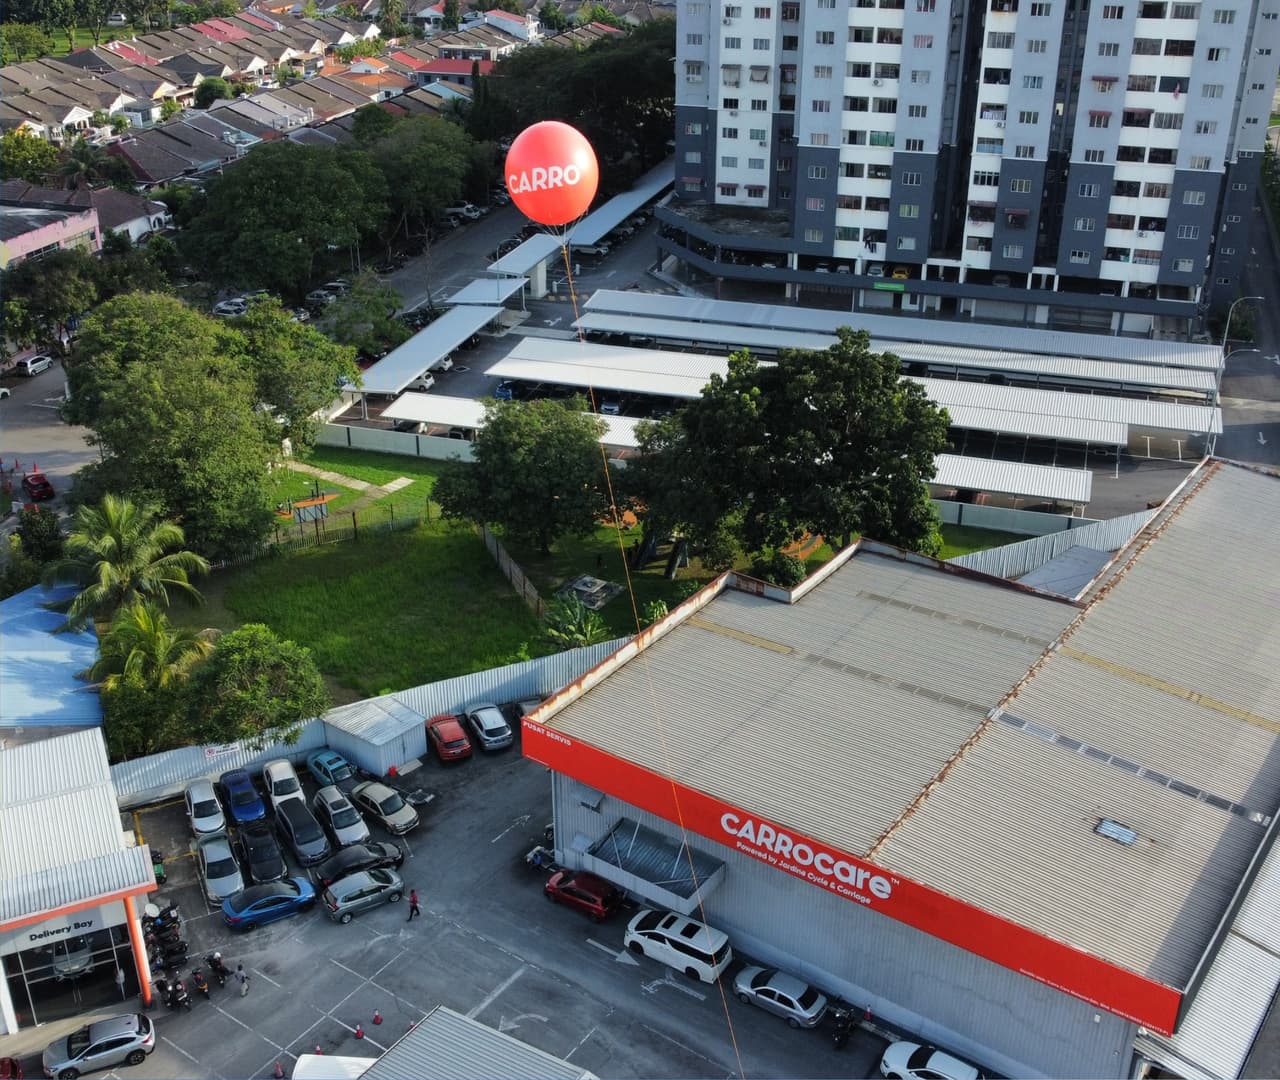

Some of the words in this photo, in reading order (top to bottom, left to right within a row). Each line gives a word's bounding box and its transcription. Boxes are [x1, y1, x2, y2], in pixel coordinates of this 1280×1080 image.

[509, 164, 581, 194] CARRO
[736, 841, 768, 860] Powered
[768, 855, 778, 864] by
[778, 860, 806, 877] Jardine
[807, 872, 829, 886] Cycle
[836, 885, 871, 904] Carriage
[29, 926, 72, 941] Delivery
[73, 920, 93, 930] Bay
